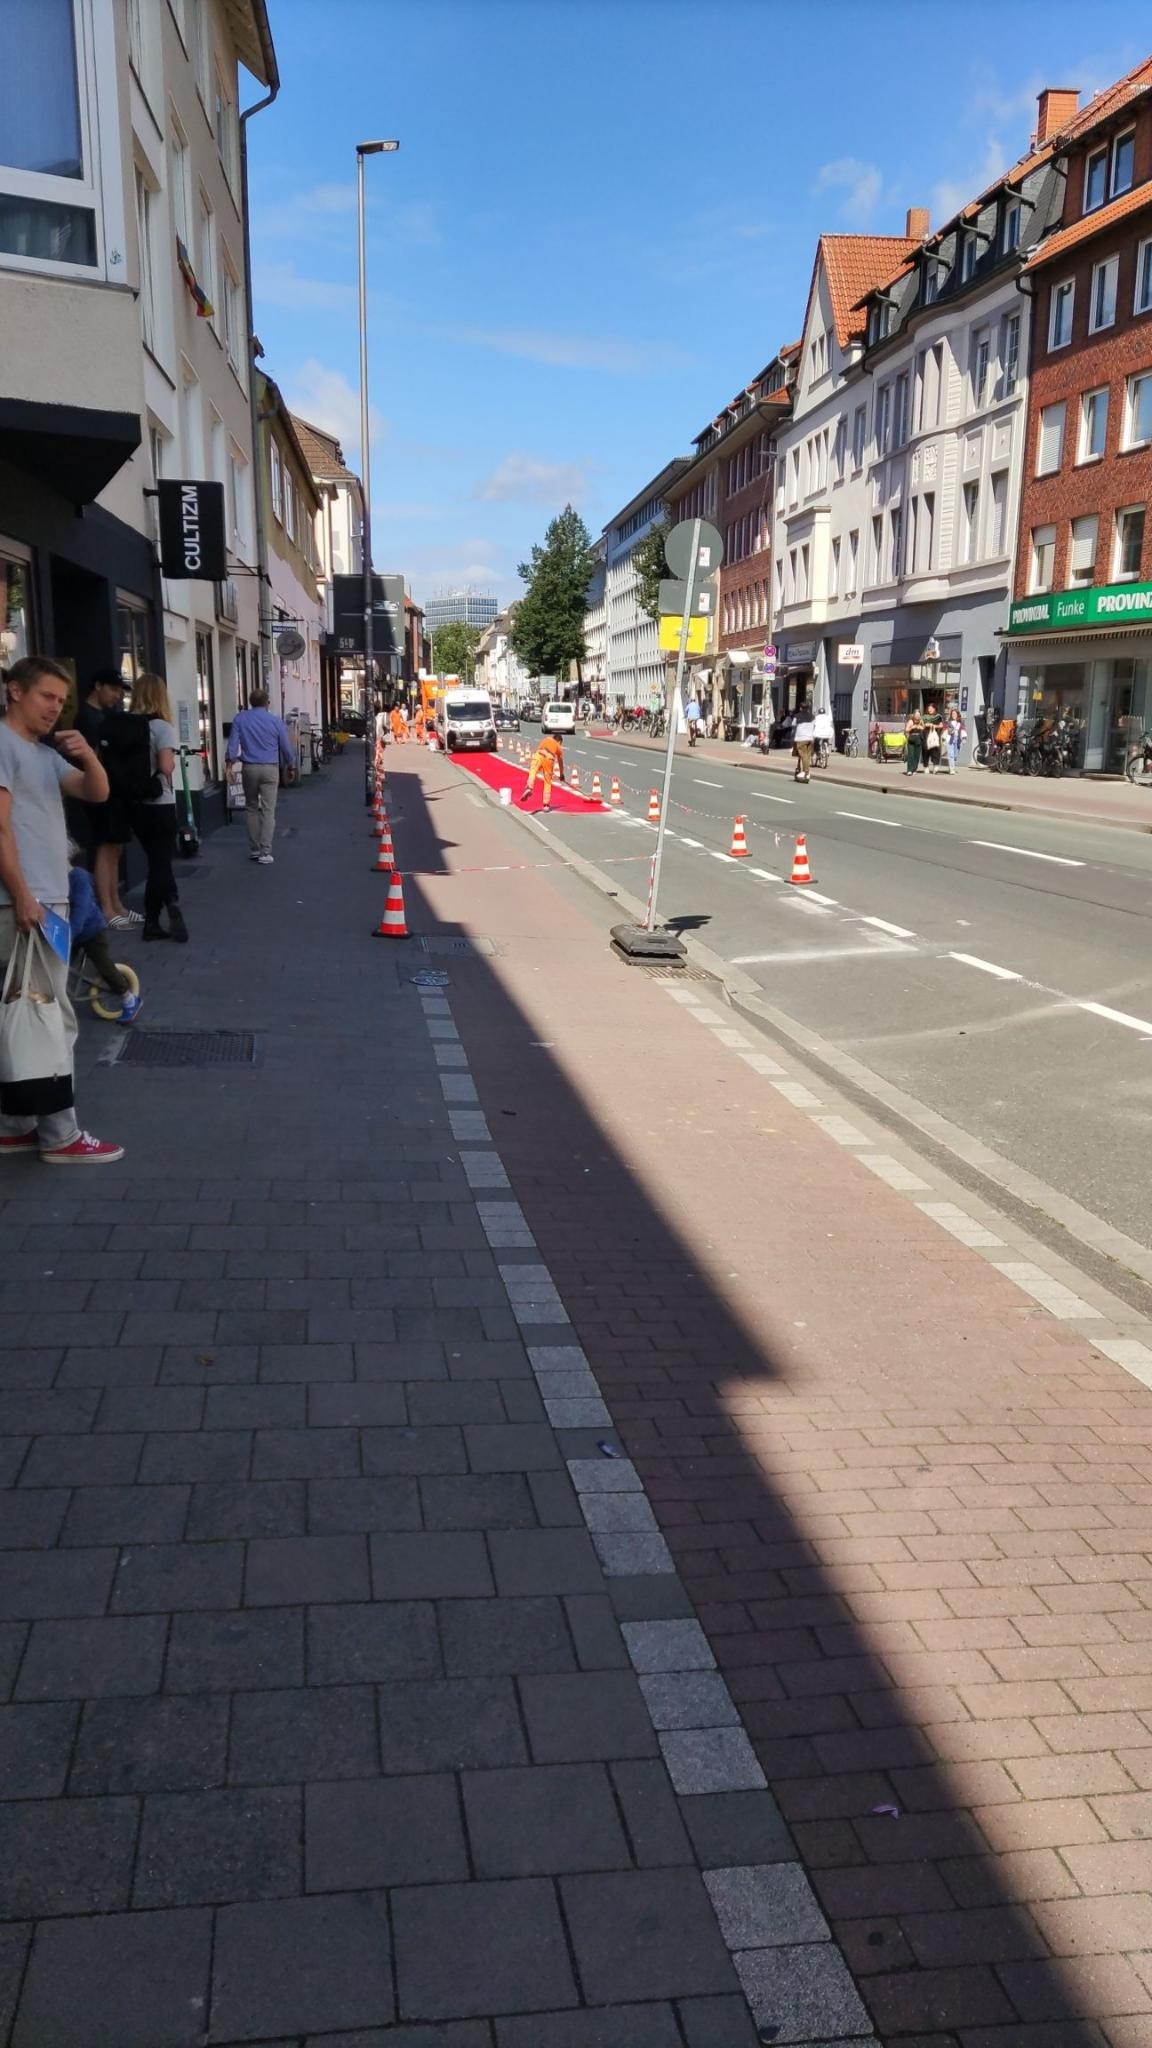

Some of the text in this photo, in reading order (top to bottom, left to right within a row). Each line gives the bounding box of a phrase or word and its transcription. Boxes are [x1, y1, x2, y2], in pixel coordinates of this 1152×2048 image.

[181, 485, 201, 570] CULTIZM
[1012, 591, 1152, 625] PROVINZIAL Funke PROVIN
